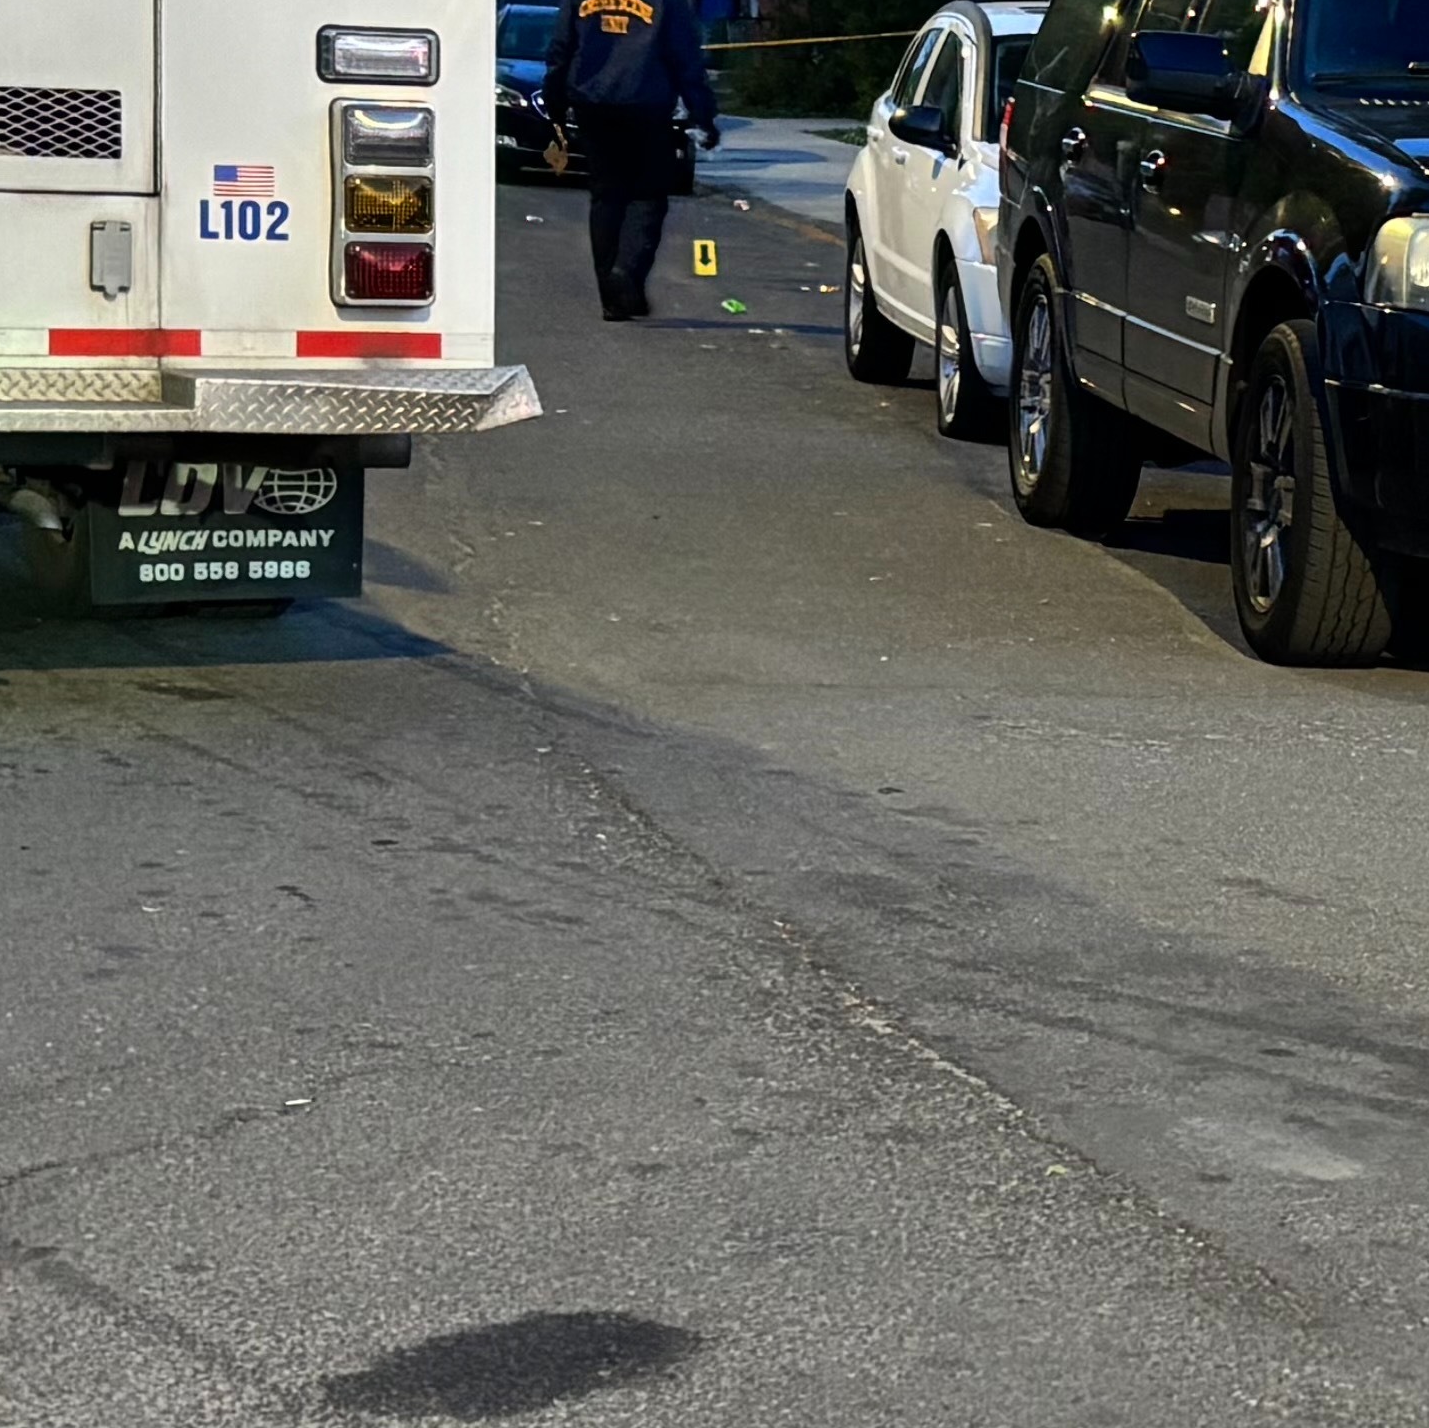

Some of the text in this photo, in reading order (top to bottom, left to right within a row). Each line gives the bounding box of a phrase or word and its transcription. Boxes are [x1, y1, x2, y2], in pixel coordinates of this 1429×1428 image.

[199, 198, 290, 242] L102
[118, 458, 270, 516] LDV
[118, 529, 336, 555] A LYNCH COMPANY
[139, 562, 185, 583] 800
